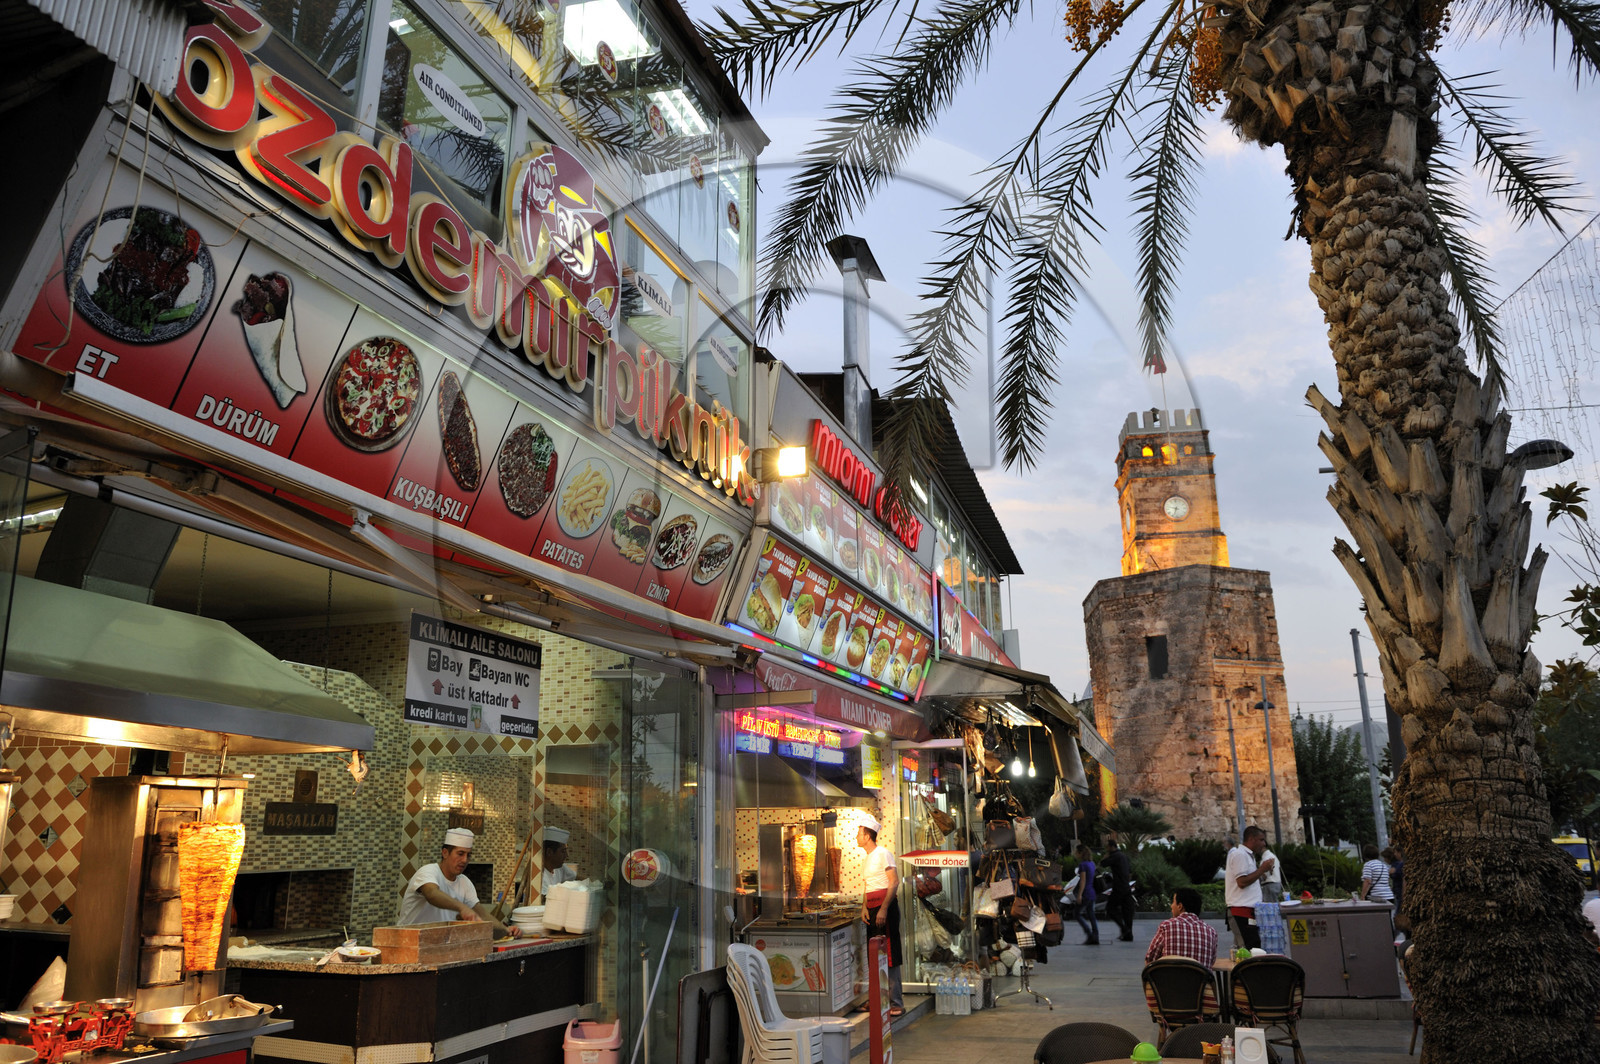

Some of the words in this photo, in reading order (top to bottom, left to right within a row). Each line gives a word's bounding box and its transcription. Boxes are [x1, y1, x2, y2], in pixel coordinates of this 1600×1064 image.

[419, 70, 433, 91] AIR
[435, 83, 483, 131] CONDITIONED
[76, 344, 119, 380] ET
[195, 394, 281, 447] DÜRÜM
[600, 338, 753, 503] piknik
[392, 477, 470, 523] KUŞBAŞILI
[540, 539, 585, 569] PATATES
[766, 540, 771, 551] 1
[772, 547, 786, 562] TAVUK
[784, 554, 797, 569] DÖNER
[800, 562, 805, 572] 2
[806, 568, 818, 582] TAVUK
[817, 574, 830, 588] DÖNER
[647, 579, 670, 603] İZMİR
[831, 580, 836, 590] 3
[419, 621, 468, 649] KLİMALI
[470, 633, 495, 654] AİLE
[497, 643, 538, 665] SALONU
[442, 655, 463, 677] Bay
[481, 664, 512, 685] Bayan
[514, 671, 530, 688] WC
[448, 682, 466, 700] üst
[468, 686, 510, 708] kattadır
[410, 704, 433, 719] kredi
[434, 708, 456, 722] kartı
[457, 714, 467, 724] ve
[500, 720, 535, 735] geçerlidir
[840, 697, 866, 725] MIAMI
[866, 704, 893, 732] DÖNER
[267, 812, 336, 829] MAŞALLAH
